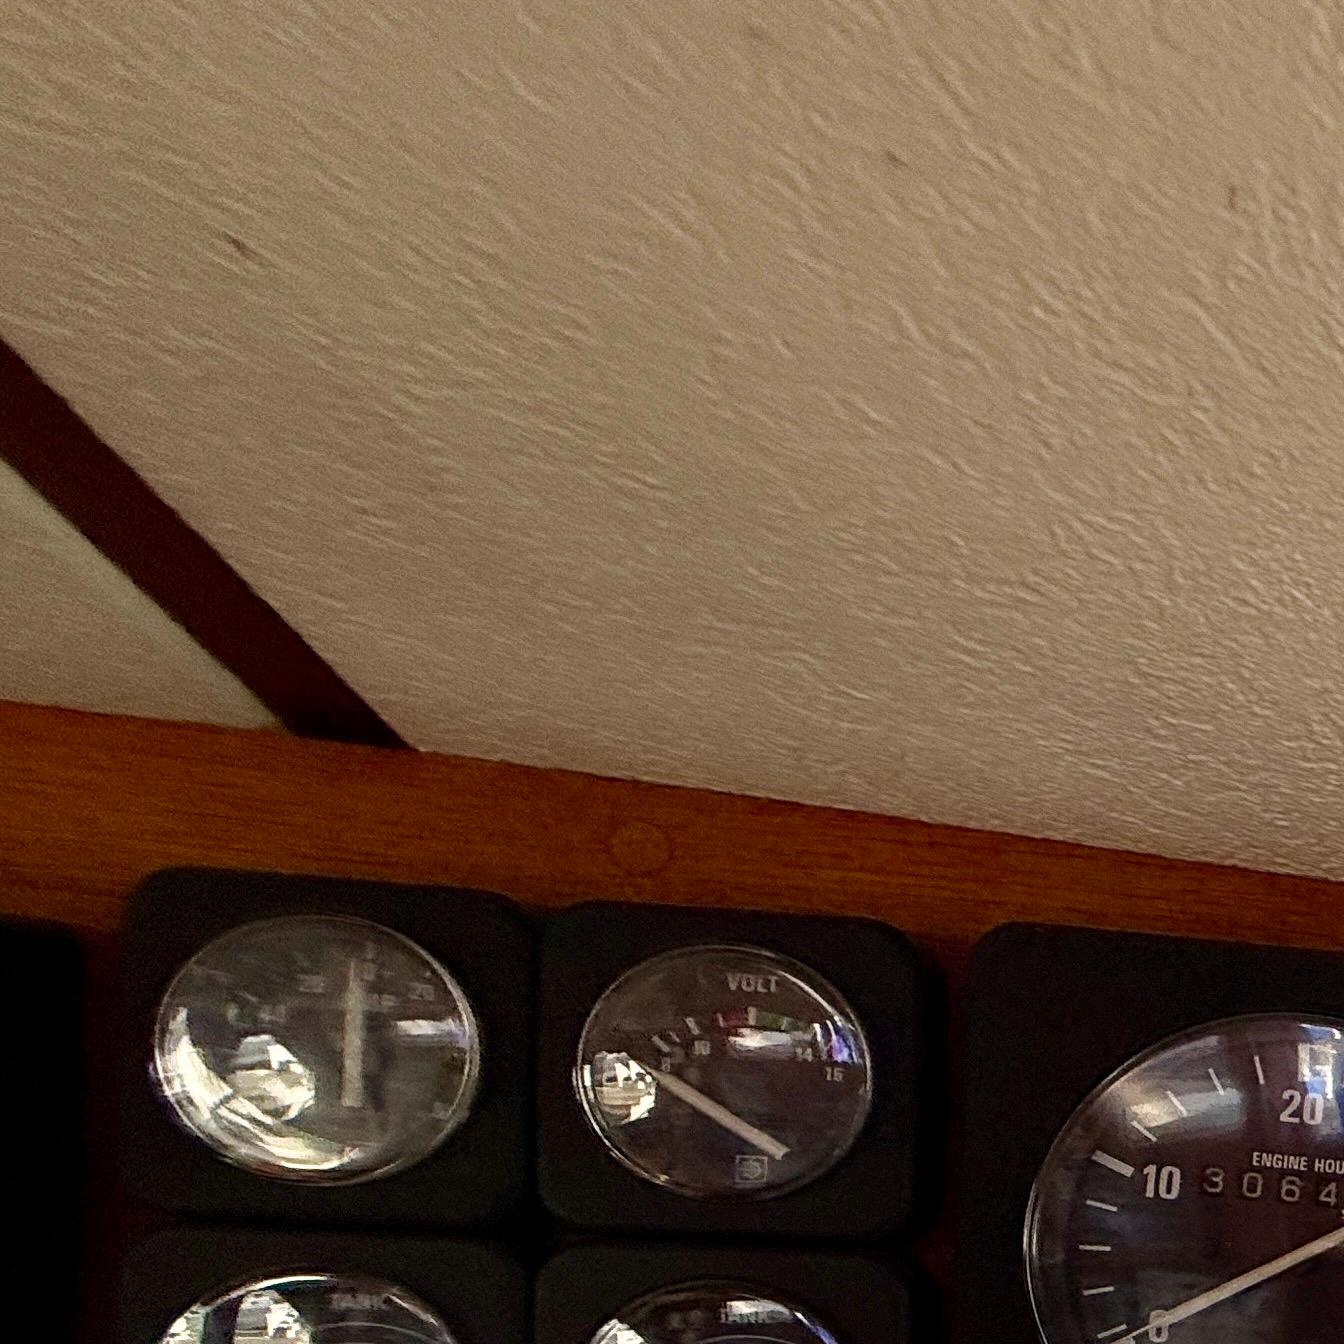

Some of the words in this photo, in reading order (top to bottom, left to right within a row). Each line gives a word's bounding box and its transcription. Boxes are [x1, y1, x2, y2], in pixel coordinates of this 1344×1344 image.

[726, 973, 780, 993] VOLT
[1279, 1089, 1325, 1125] 20
[1252, 1151, 1309, 1171] ENGINE
[1143, 1164, 1182, 1200] 10
[1147, 1310, 1171, 1343] 0
